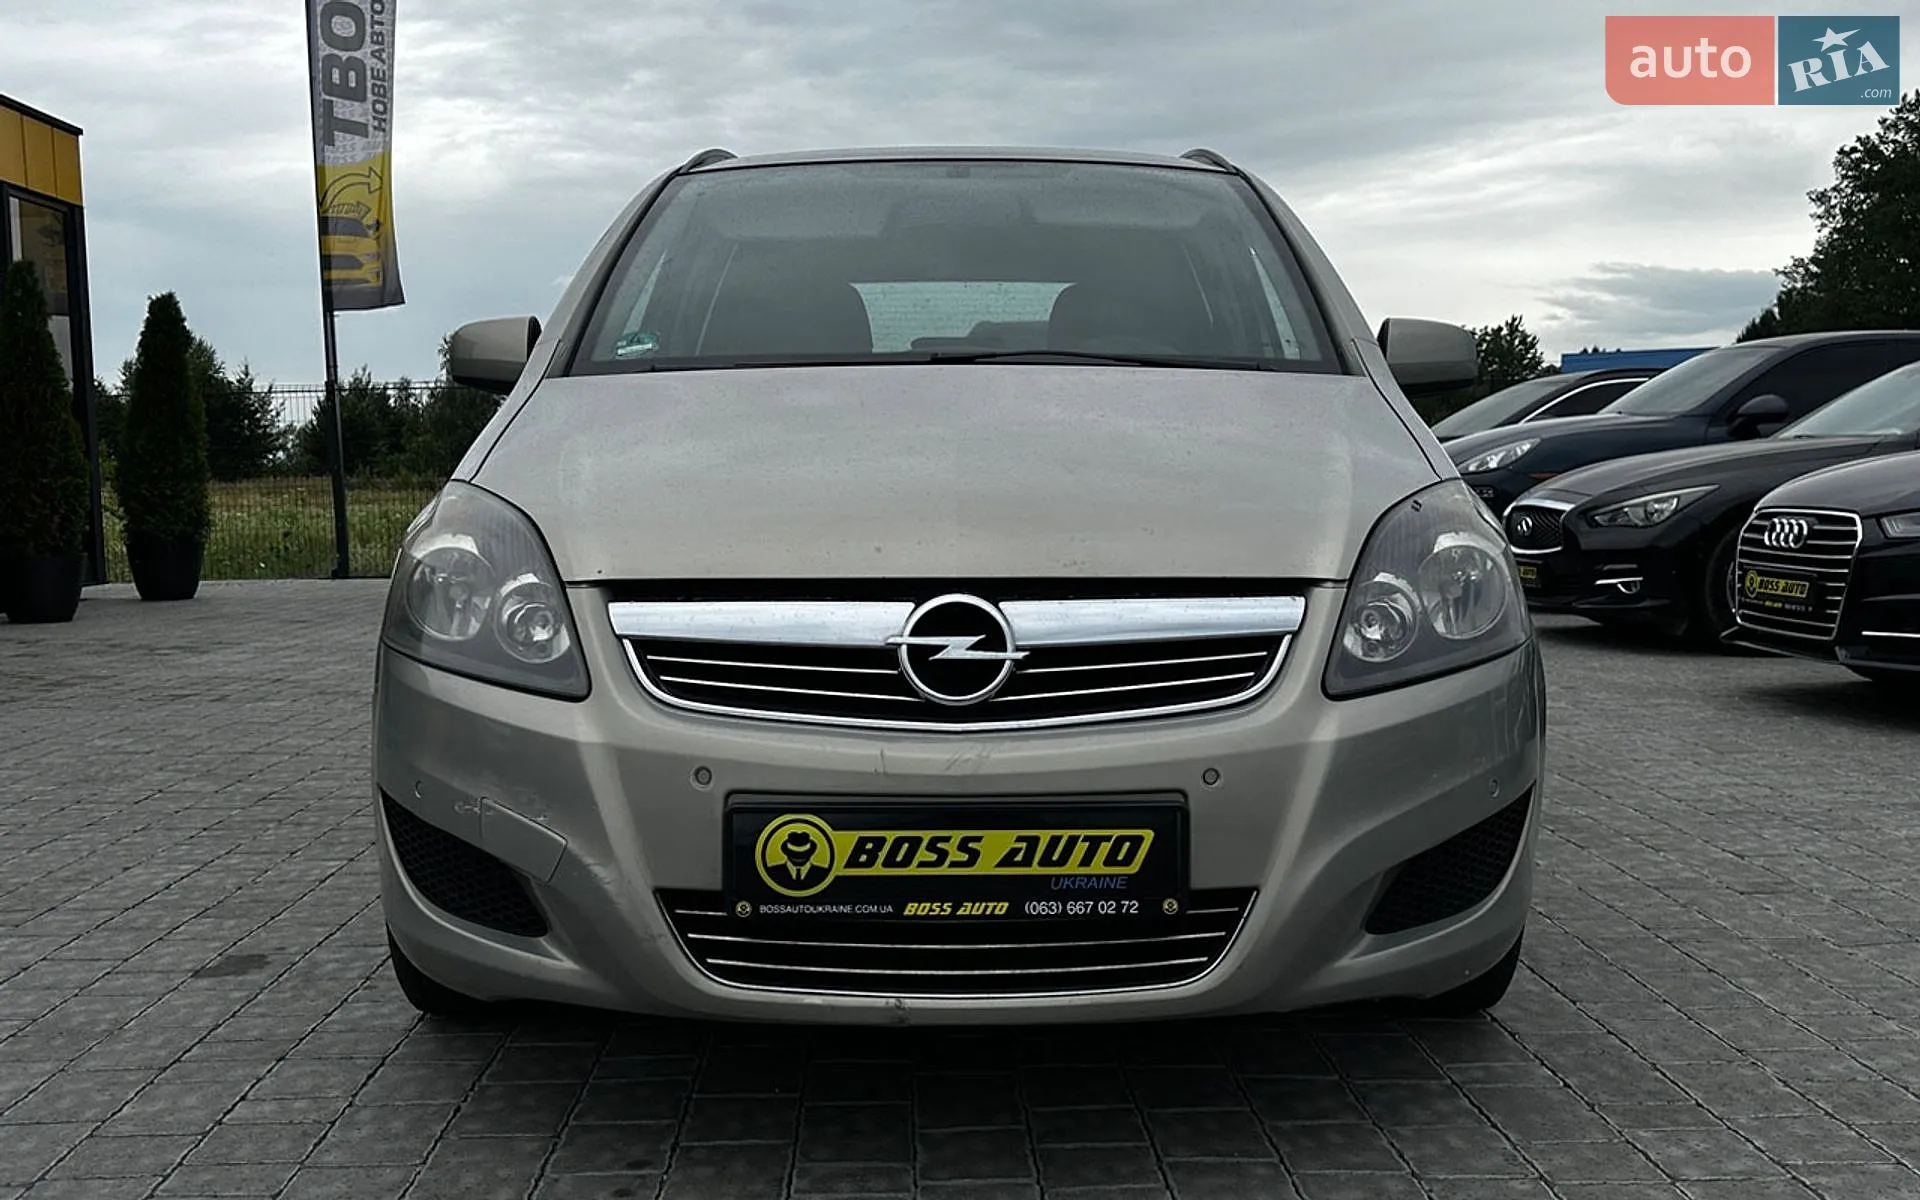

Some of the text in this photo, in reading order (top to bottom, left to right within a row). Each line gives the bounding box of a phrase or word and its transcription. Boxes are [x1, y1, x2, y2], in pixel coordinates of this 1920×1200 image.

[843, 834, 1147, 869] BOSS AUTO
[1050, 876, 1128, 890] UKRAINE
[903, 901, 1009, 916] BOSS AUTO
[1024, 900, 1139, 916] (063) 667 02 72
